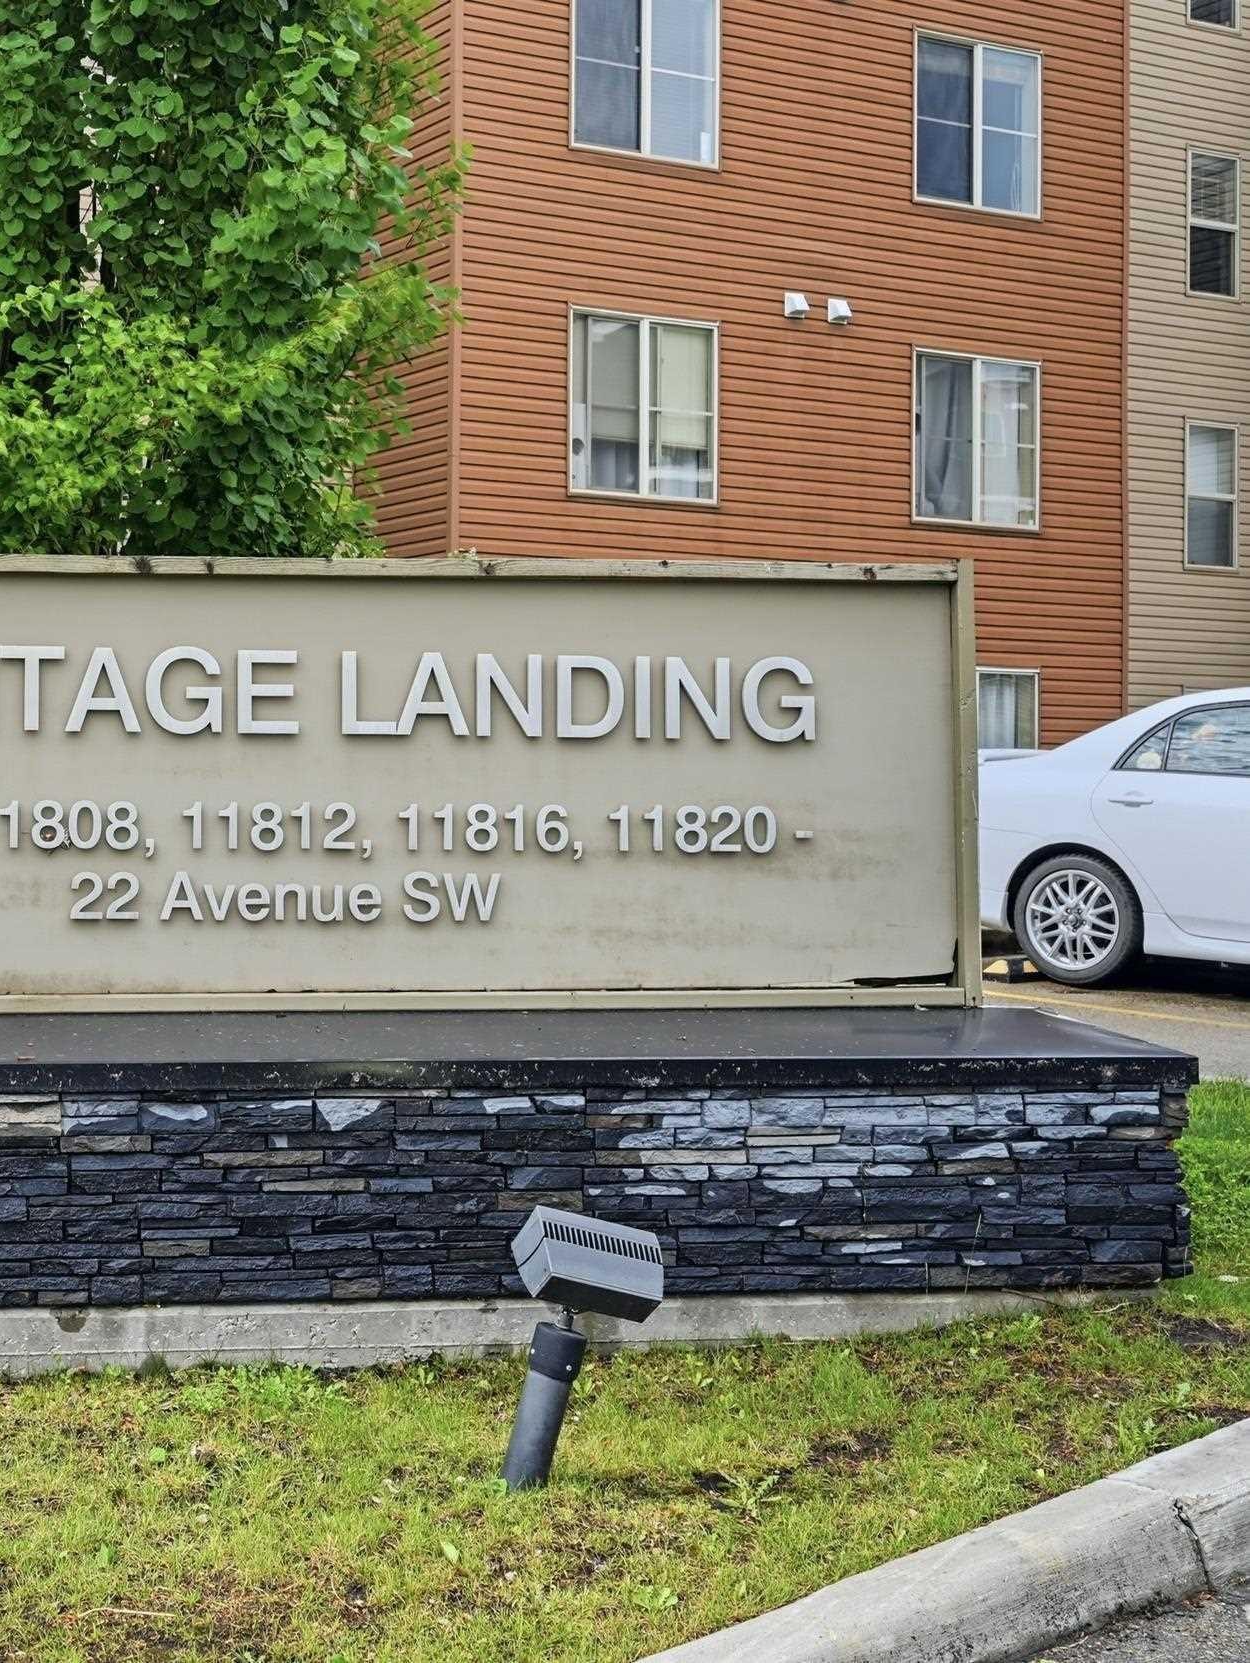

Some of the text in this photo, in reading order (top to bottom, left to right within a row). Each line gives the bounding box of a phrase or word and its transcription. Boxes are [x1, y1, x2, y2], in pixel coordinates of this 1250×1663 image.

[341, 650, 817, 742] LANDING
[183, 801, 373, 859] 11812,
[399, 803, 583, 860] 11816,
[607, 804, 777, 854] 11820
[69, 871, 501, 923] 22 Avenue SW
